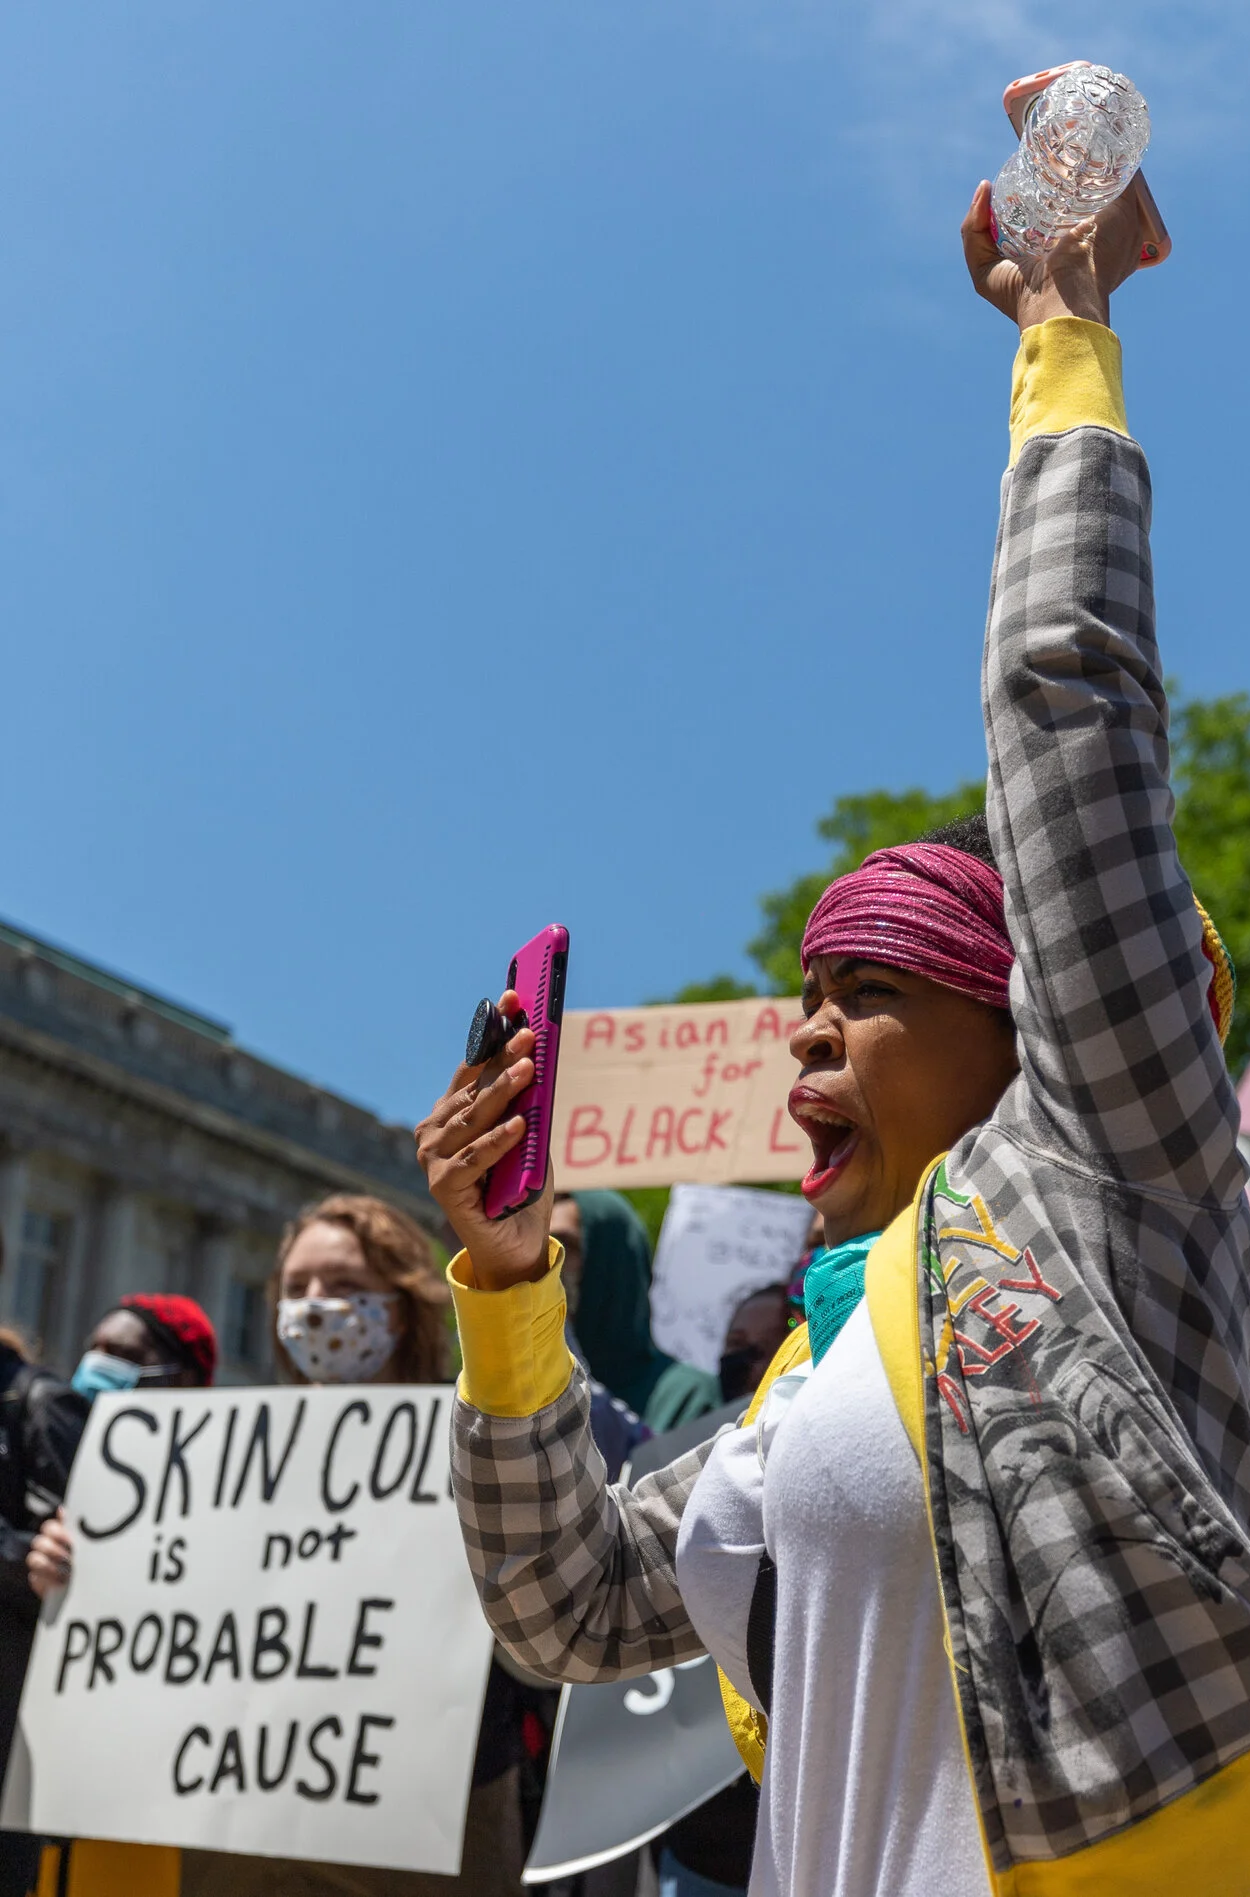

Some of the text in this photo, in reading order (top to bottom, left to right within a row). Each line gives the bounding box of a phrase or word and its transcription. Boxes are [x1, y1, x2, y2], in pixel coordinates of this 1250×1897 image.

[584, 1013, 729, 1053] Asian
[692, 1052, 763, 1097] for
[564, 1105, 733, 1169] BLACK
[79, 1399, 456, 1540] SKIN COL
[149, 1522, 356, 1584] is not
[56, 1598, 396, 1694] PROBABLE
[173, 1713, 396, 1806] CAUSE
